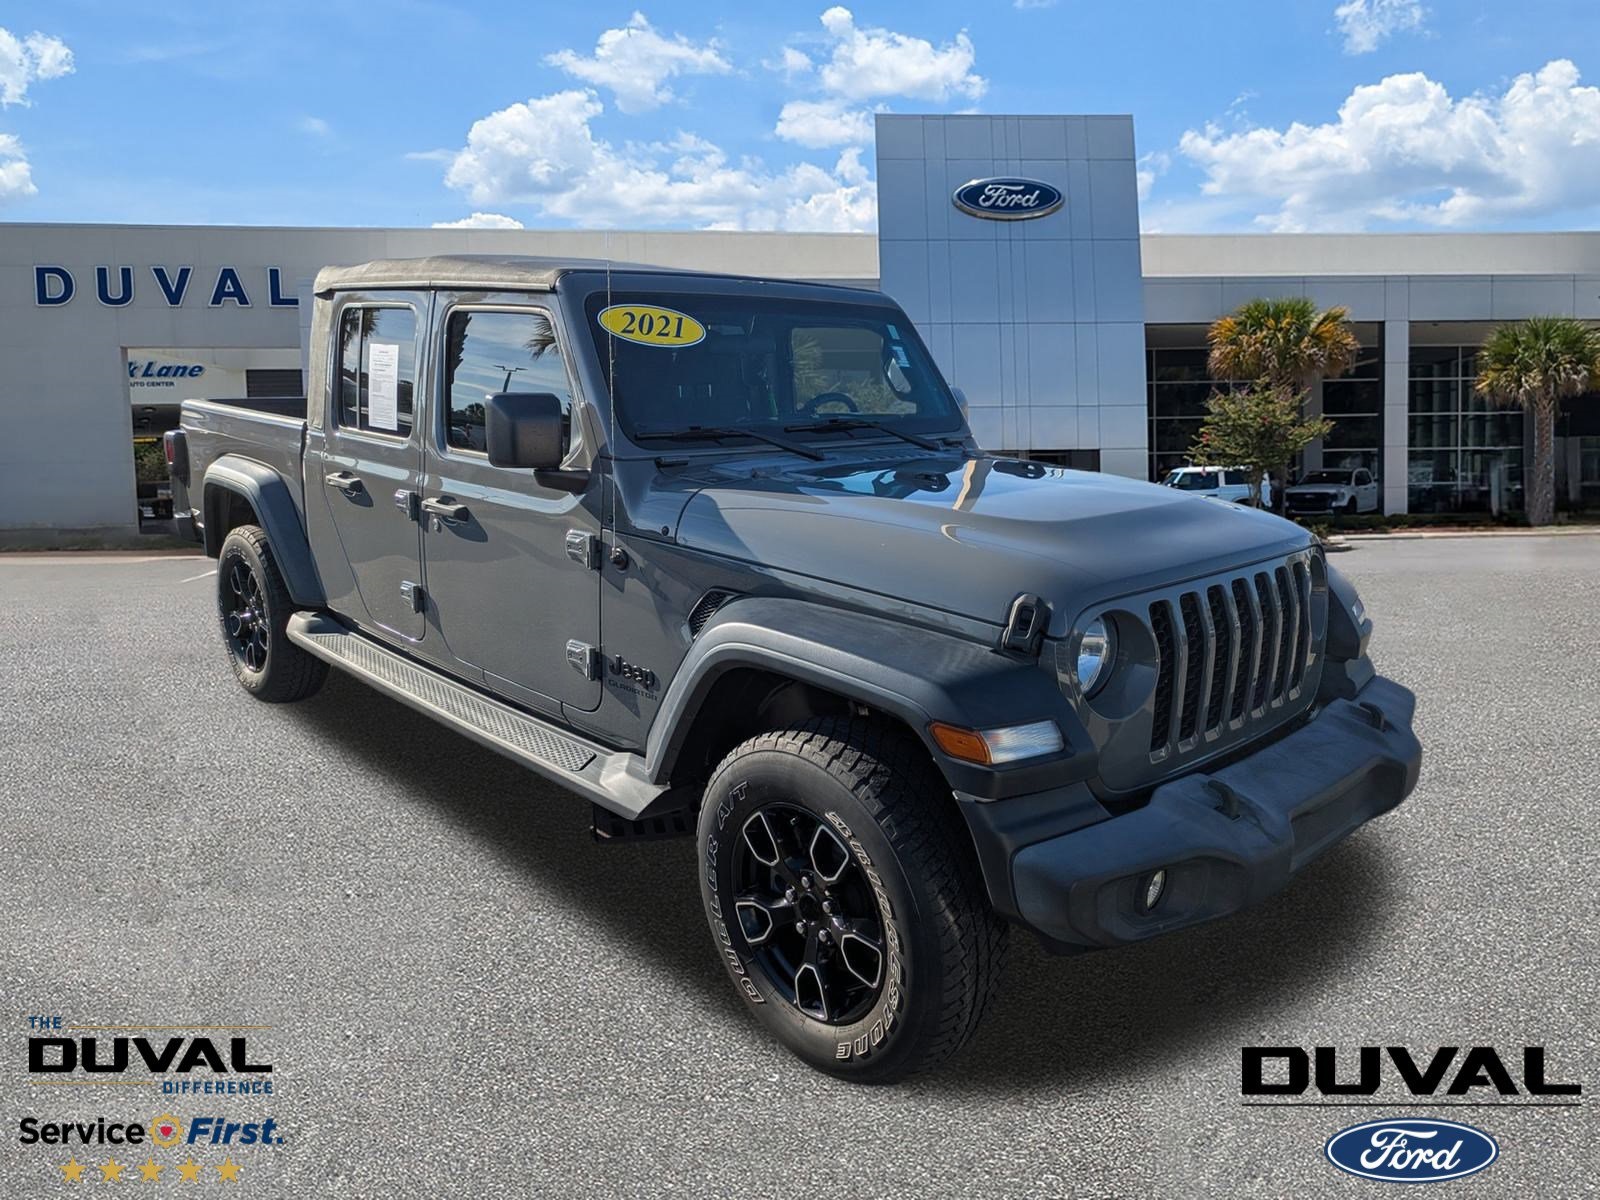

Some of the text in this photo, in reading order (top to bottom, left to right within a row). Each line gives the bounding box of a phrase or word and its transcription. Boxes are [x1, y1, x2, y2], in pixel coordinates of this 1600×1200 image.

[978, 183, 1041, 207] Ford
[33, 265, 299, 307] DUVAL
[620, 312, 684, 339] 2021
[141, 361, 205, 378] Lane
[608, 654, 656, 691] Jeep
[824, 811, 902, 1060] BRIDGESTONE
